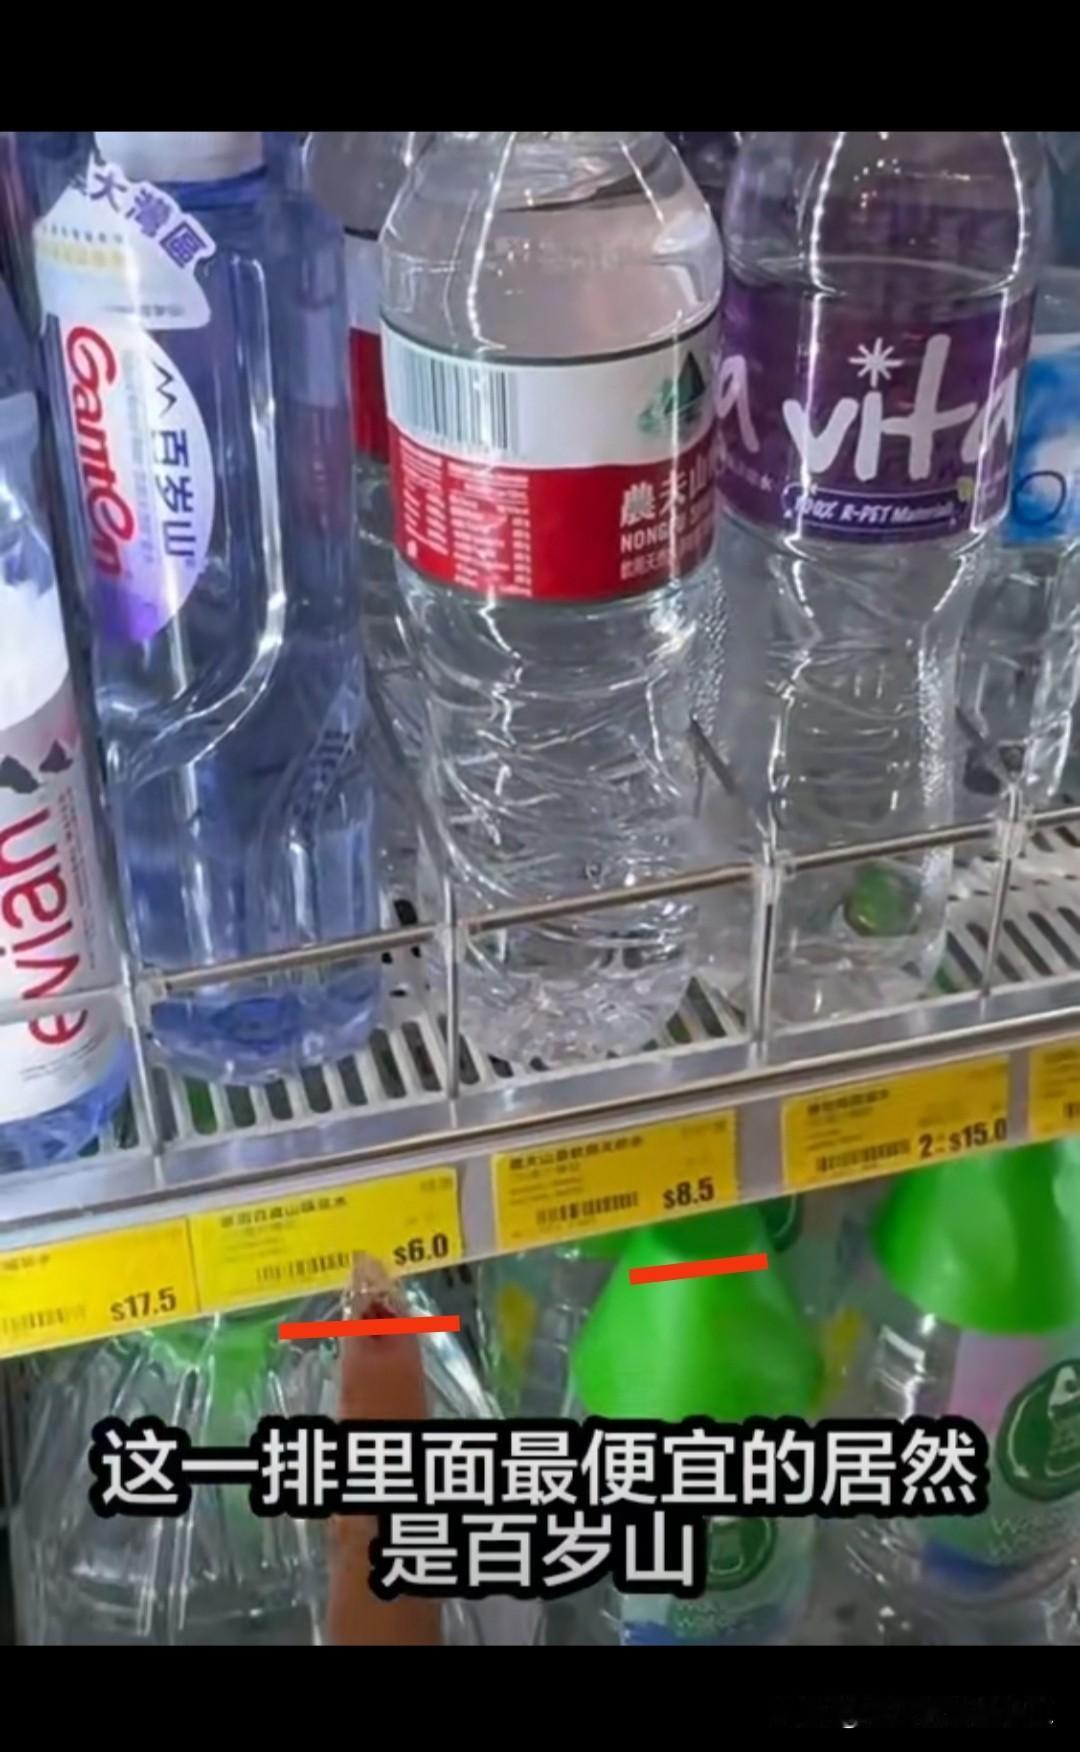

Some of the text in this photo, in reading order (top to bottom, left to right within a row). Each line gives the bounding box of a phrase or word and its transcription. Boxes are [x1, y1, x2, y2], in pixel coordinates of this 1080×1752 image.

[152, 429, 198, 557] 百岁山
[0, 807, 88, 1046] evian
[662, 1176, 715, 1210] $8.5
[393, 1232, 450, 1267] $6.0
[110, 1286, 177, 1323] $17.5
